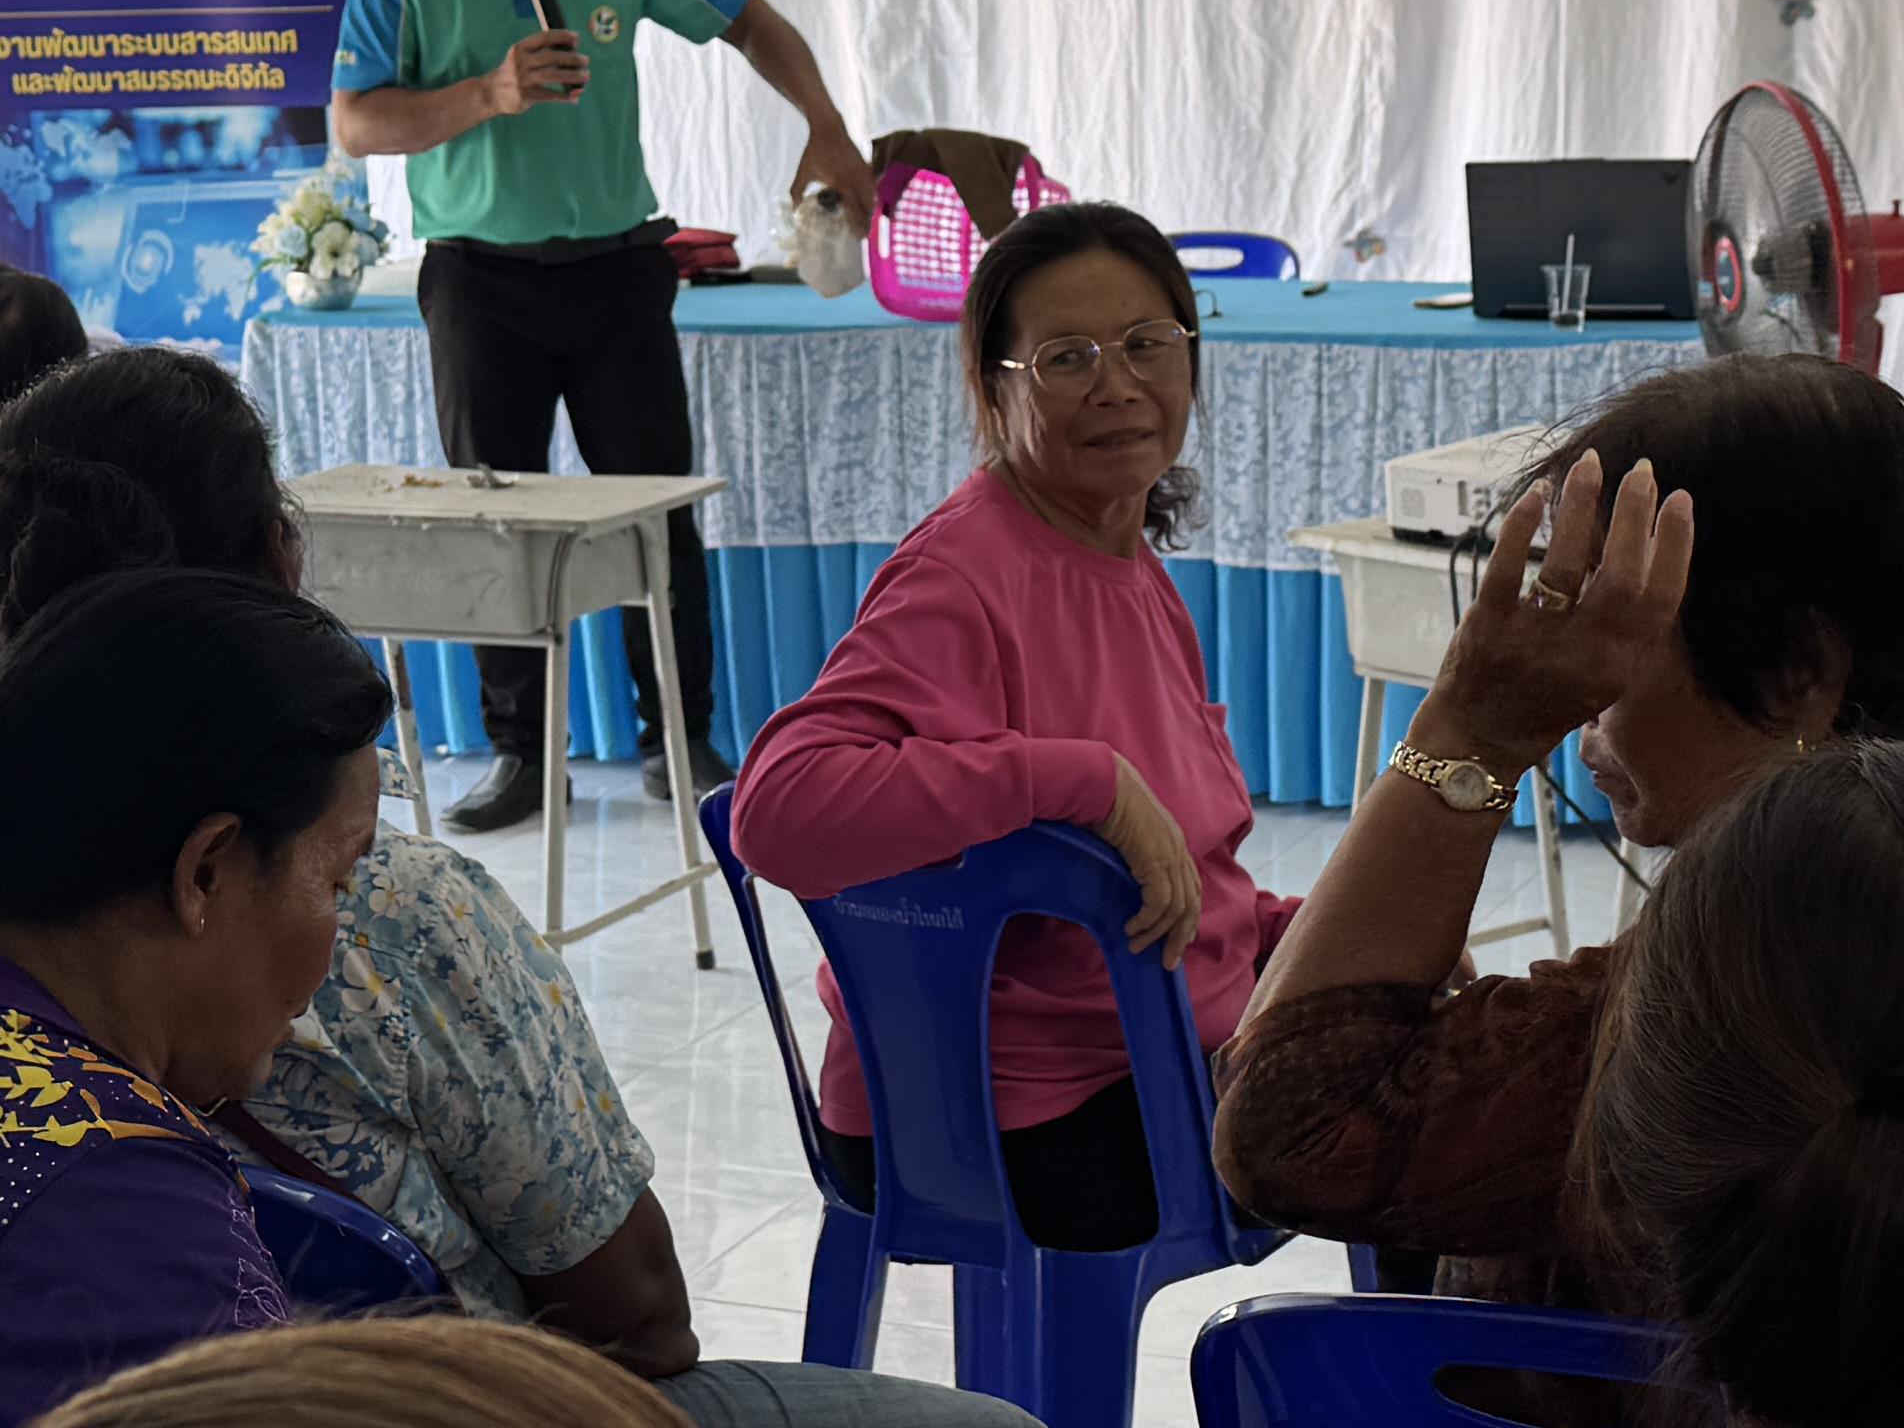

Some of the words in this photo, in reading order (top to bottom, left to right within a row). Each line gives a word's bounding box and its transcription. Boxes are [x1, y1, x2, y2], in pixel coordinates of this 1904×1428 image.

[11, 60, 287, 95] และพัฒนาสมรรถนะดิจิทัล
